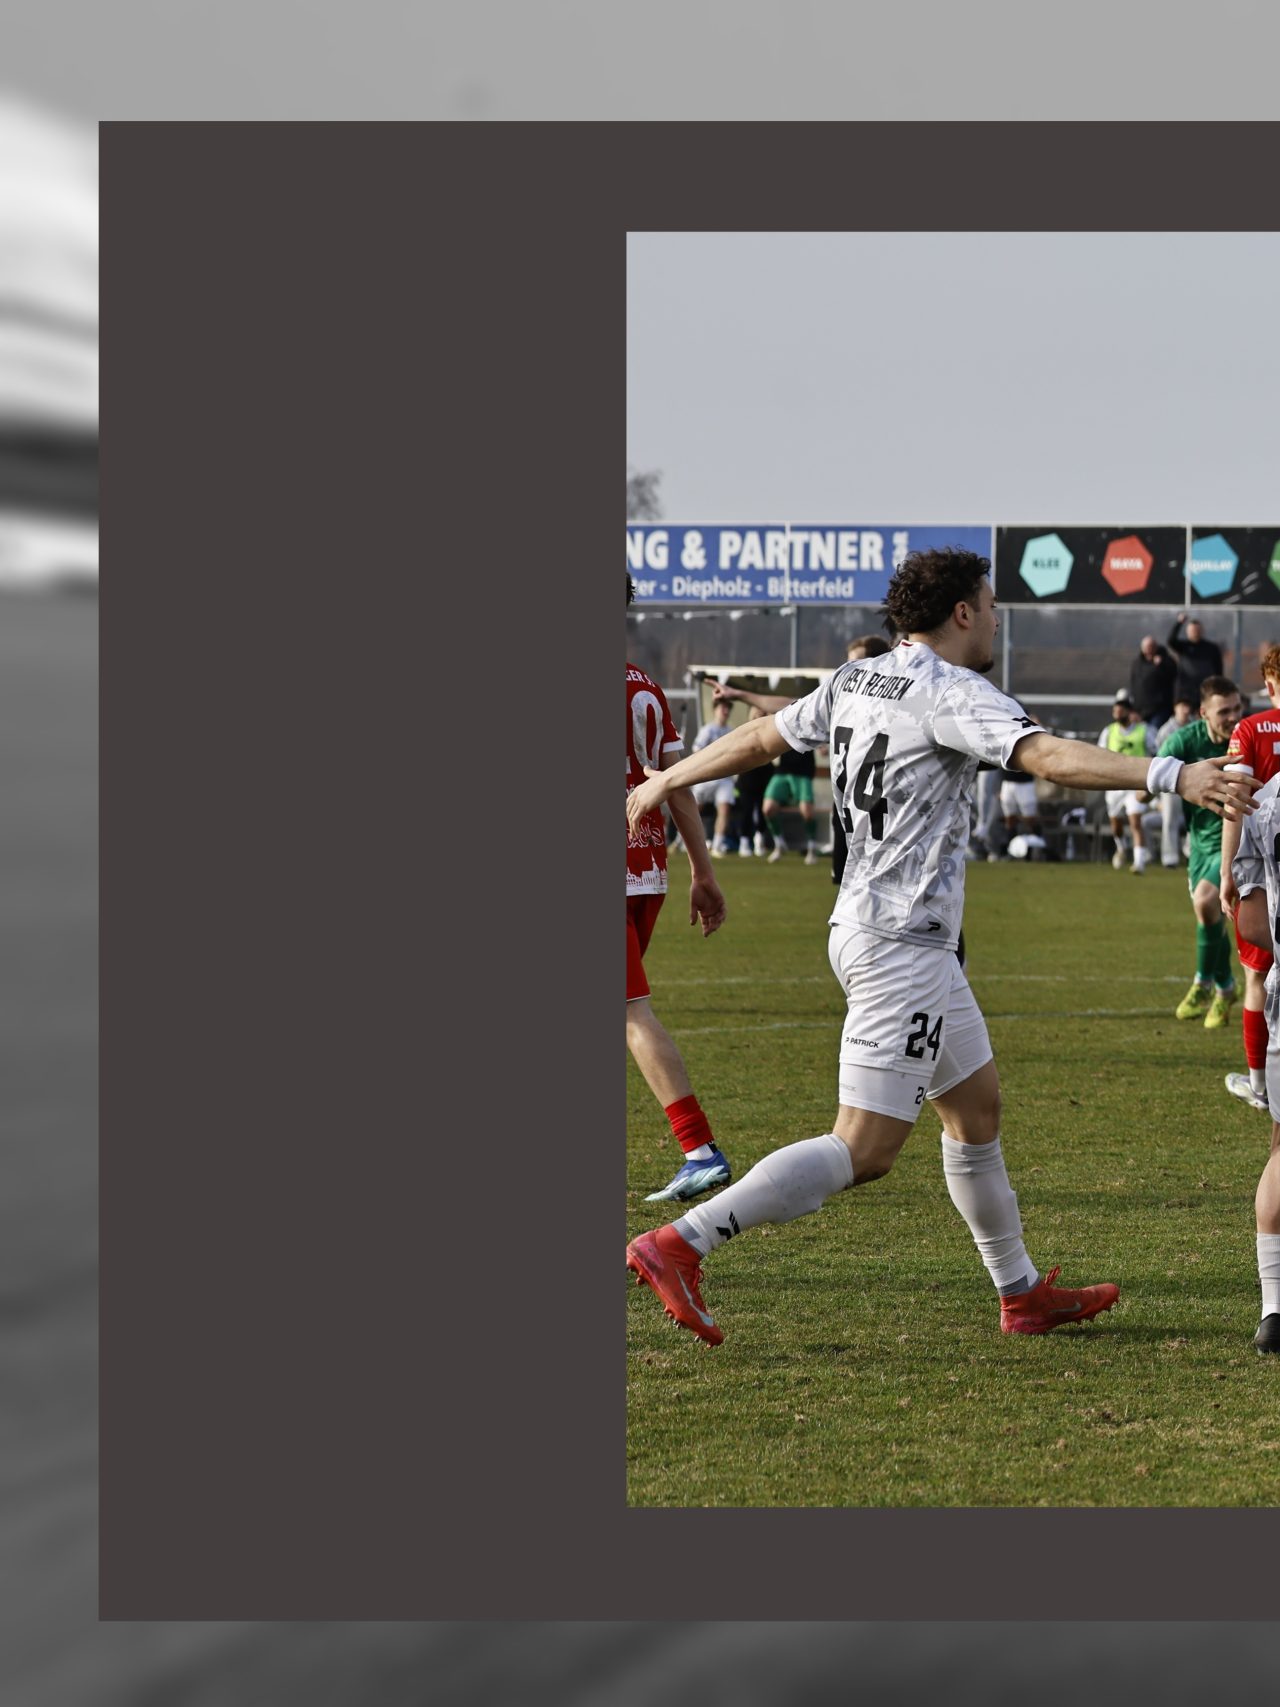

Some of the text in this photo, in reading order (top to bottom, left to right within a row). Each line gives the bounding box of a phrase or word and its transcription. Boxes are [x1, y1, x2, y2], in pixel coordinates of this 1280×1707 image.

[626, 530, 884, 571] NG & PARTNER
[672, 575, 752, 601] Diepholz
[767, 576, 854, 598] Bitterfeld
[861, 672, 915, 701] REHDEN
[850, 1037, 880, 1049] PATRICK
[905, 1012, 943, 1062] 24
